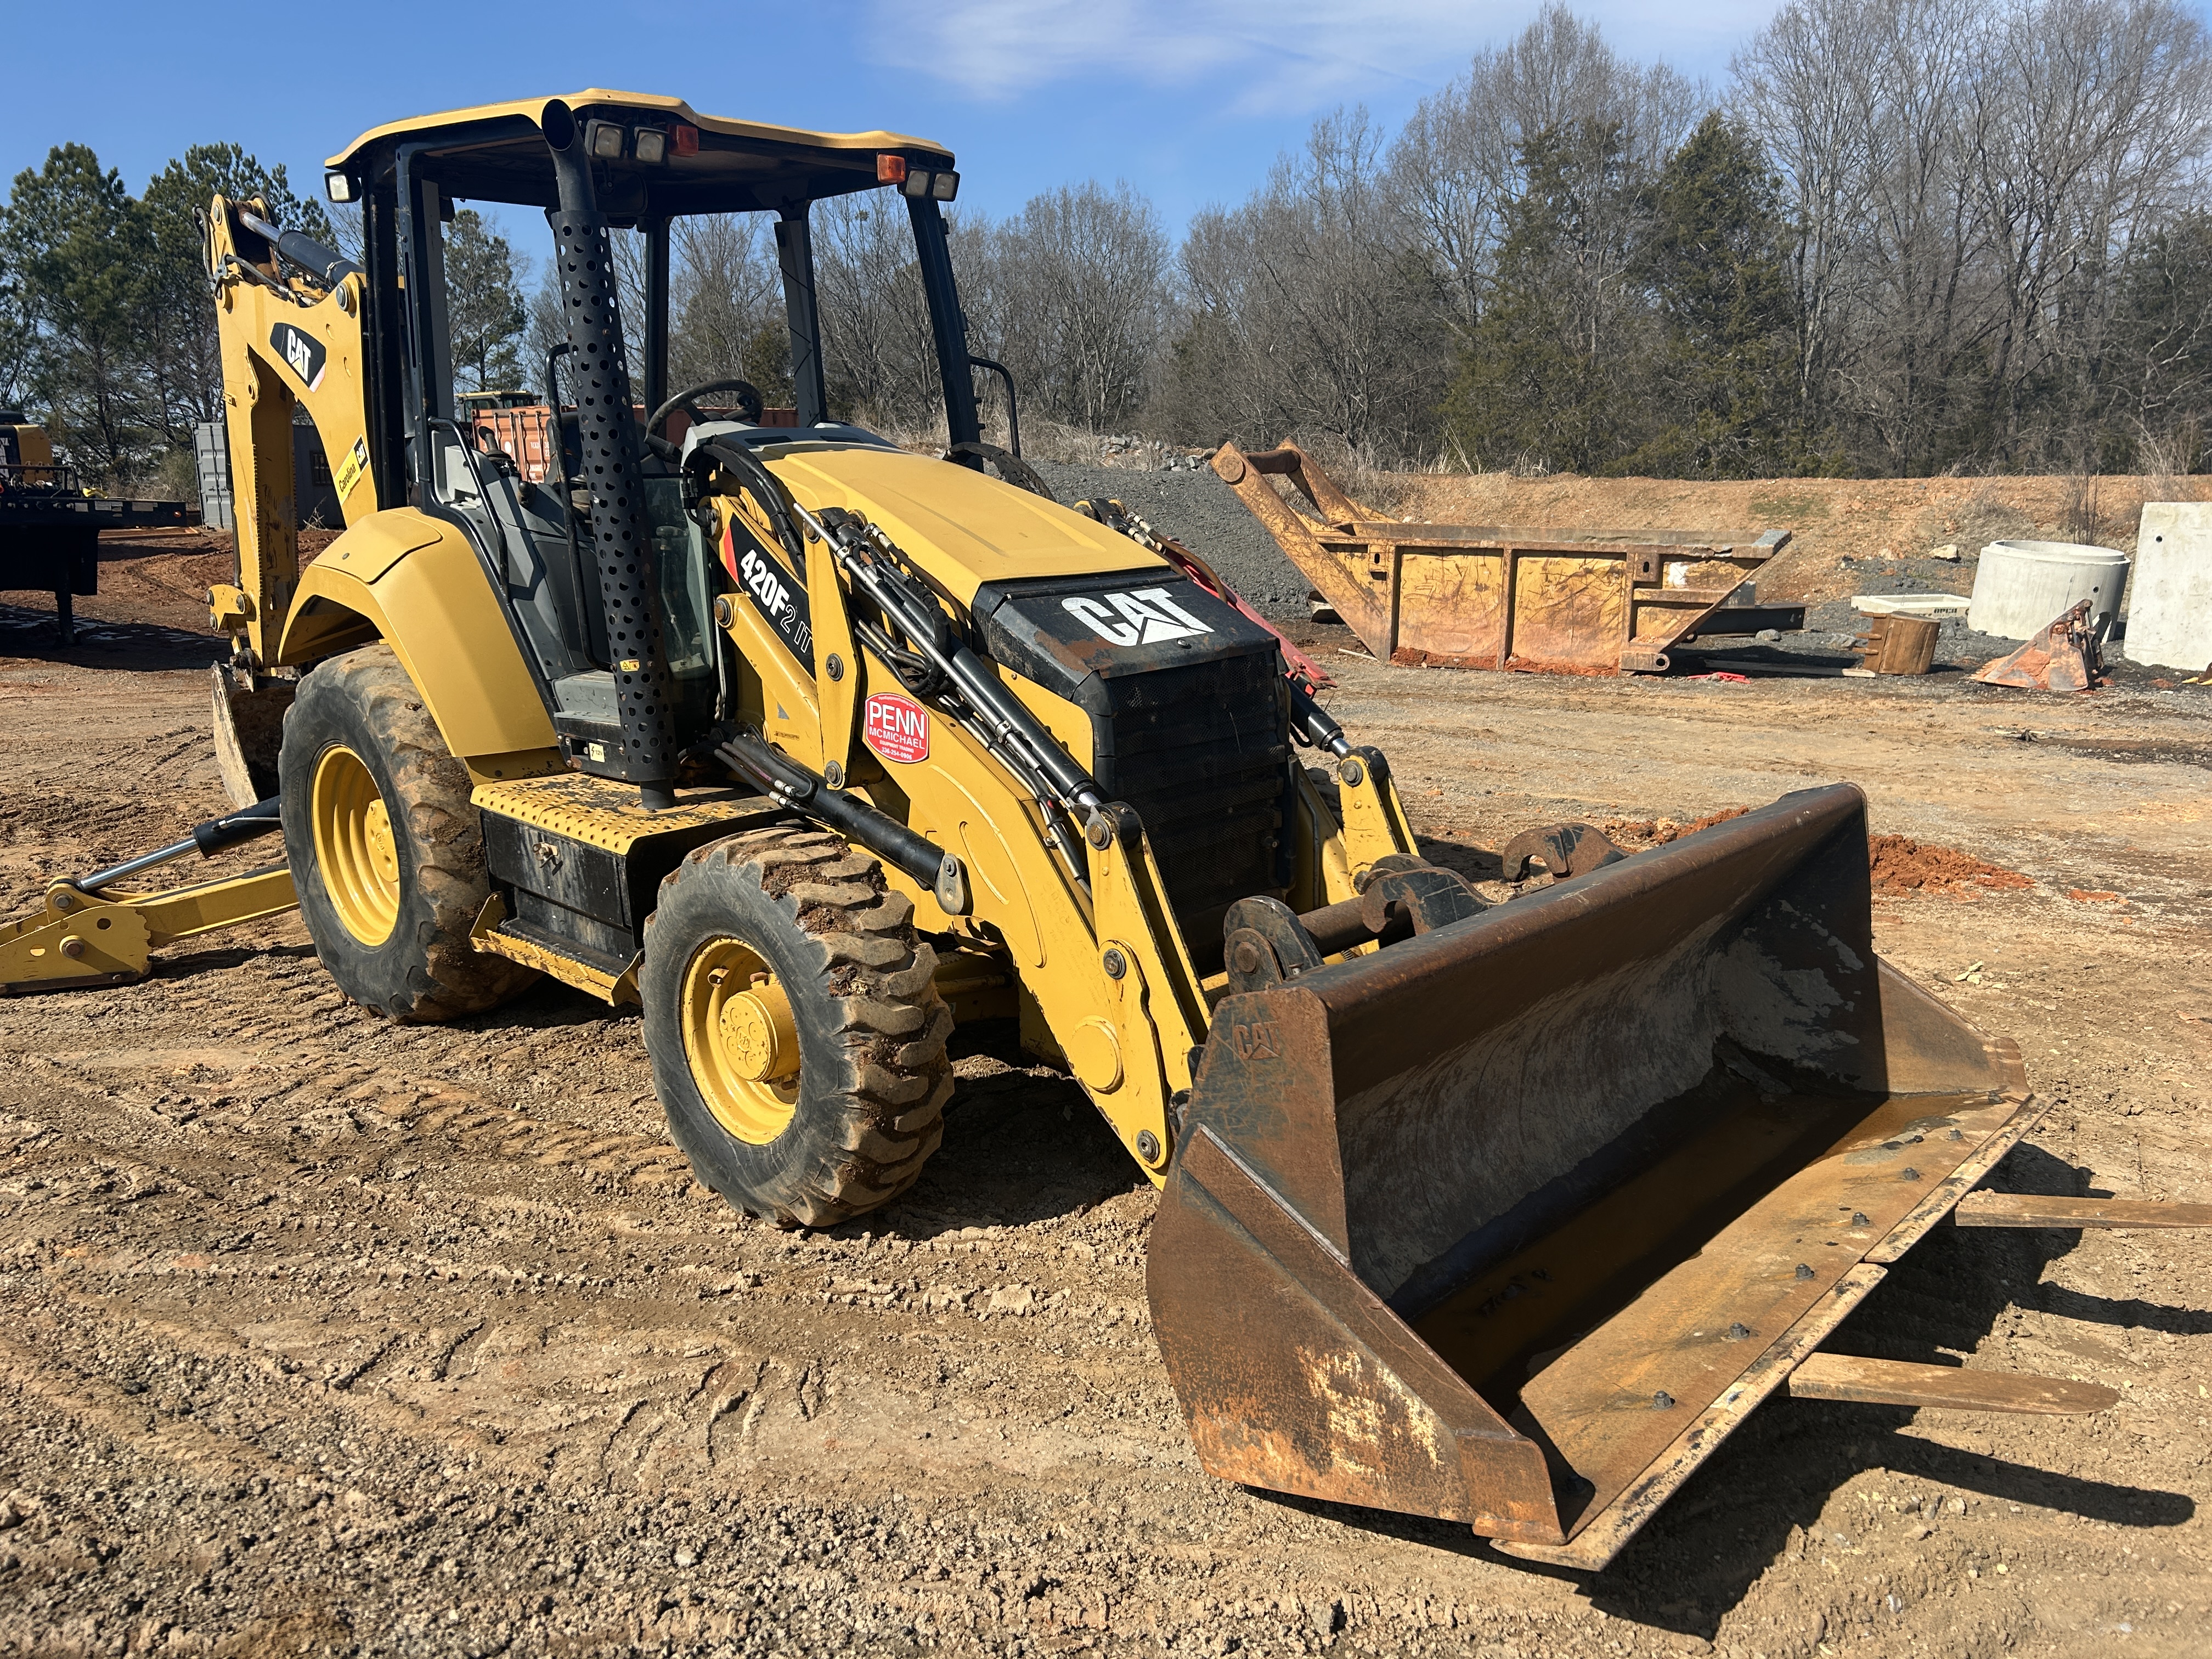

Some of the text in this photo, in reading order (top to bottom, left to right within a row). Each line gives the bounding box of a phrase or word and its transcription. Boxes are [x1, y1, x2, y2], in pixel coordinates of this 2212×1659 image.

[287, 328, 311, 382] CAT
[338, 463, 356, 493] Carolina
[1061, 588, 1215, 646] CAT
[869, 701, 924, 739] PENN
[869, 726, 925, 749] MCMICHAEL
[879, 740, 914, 753] EQUIPMENT TRADING
[1234, 1020, 1282, 1060] CAT
